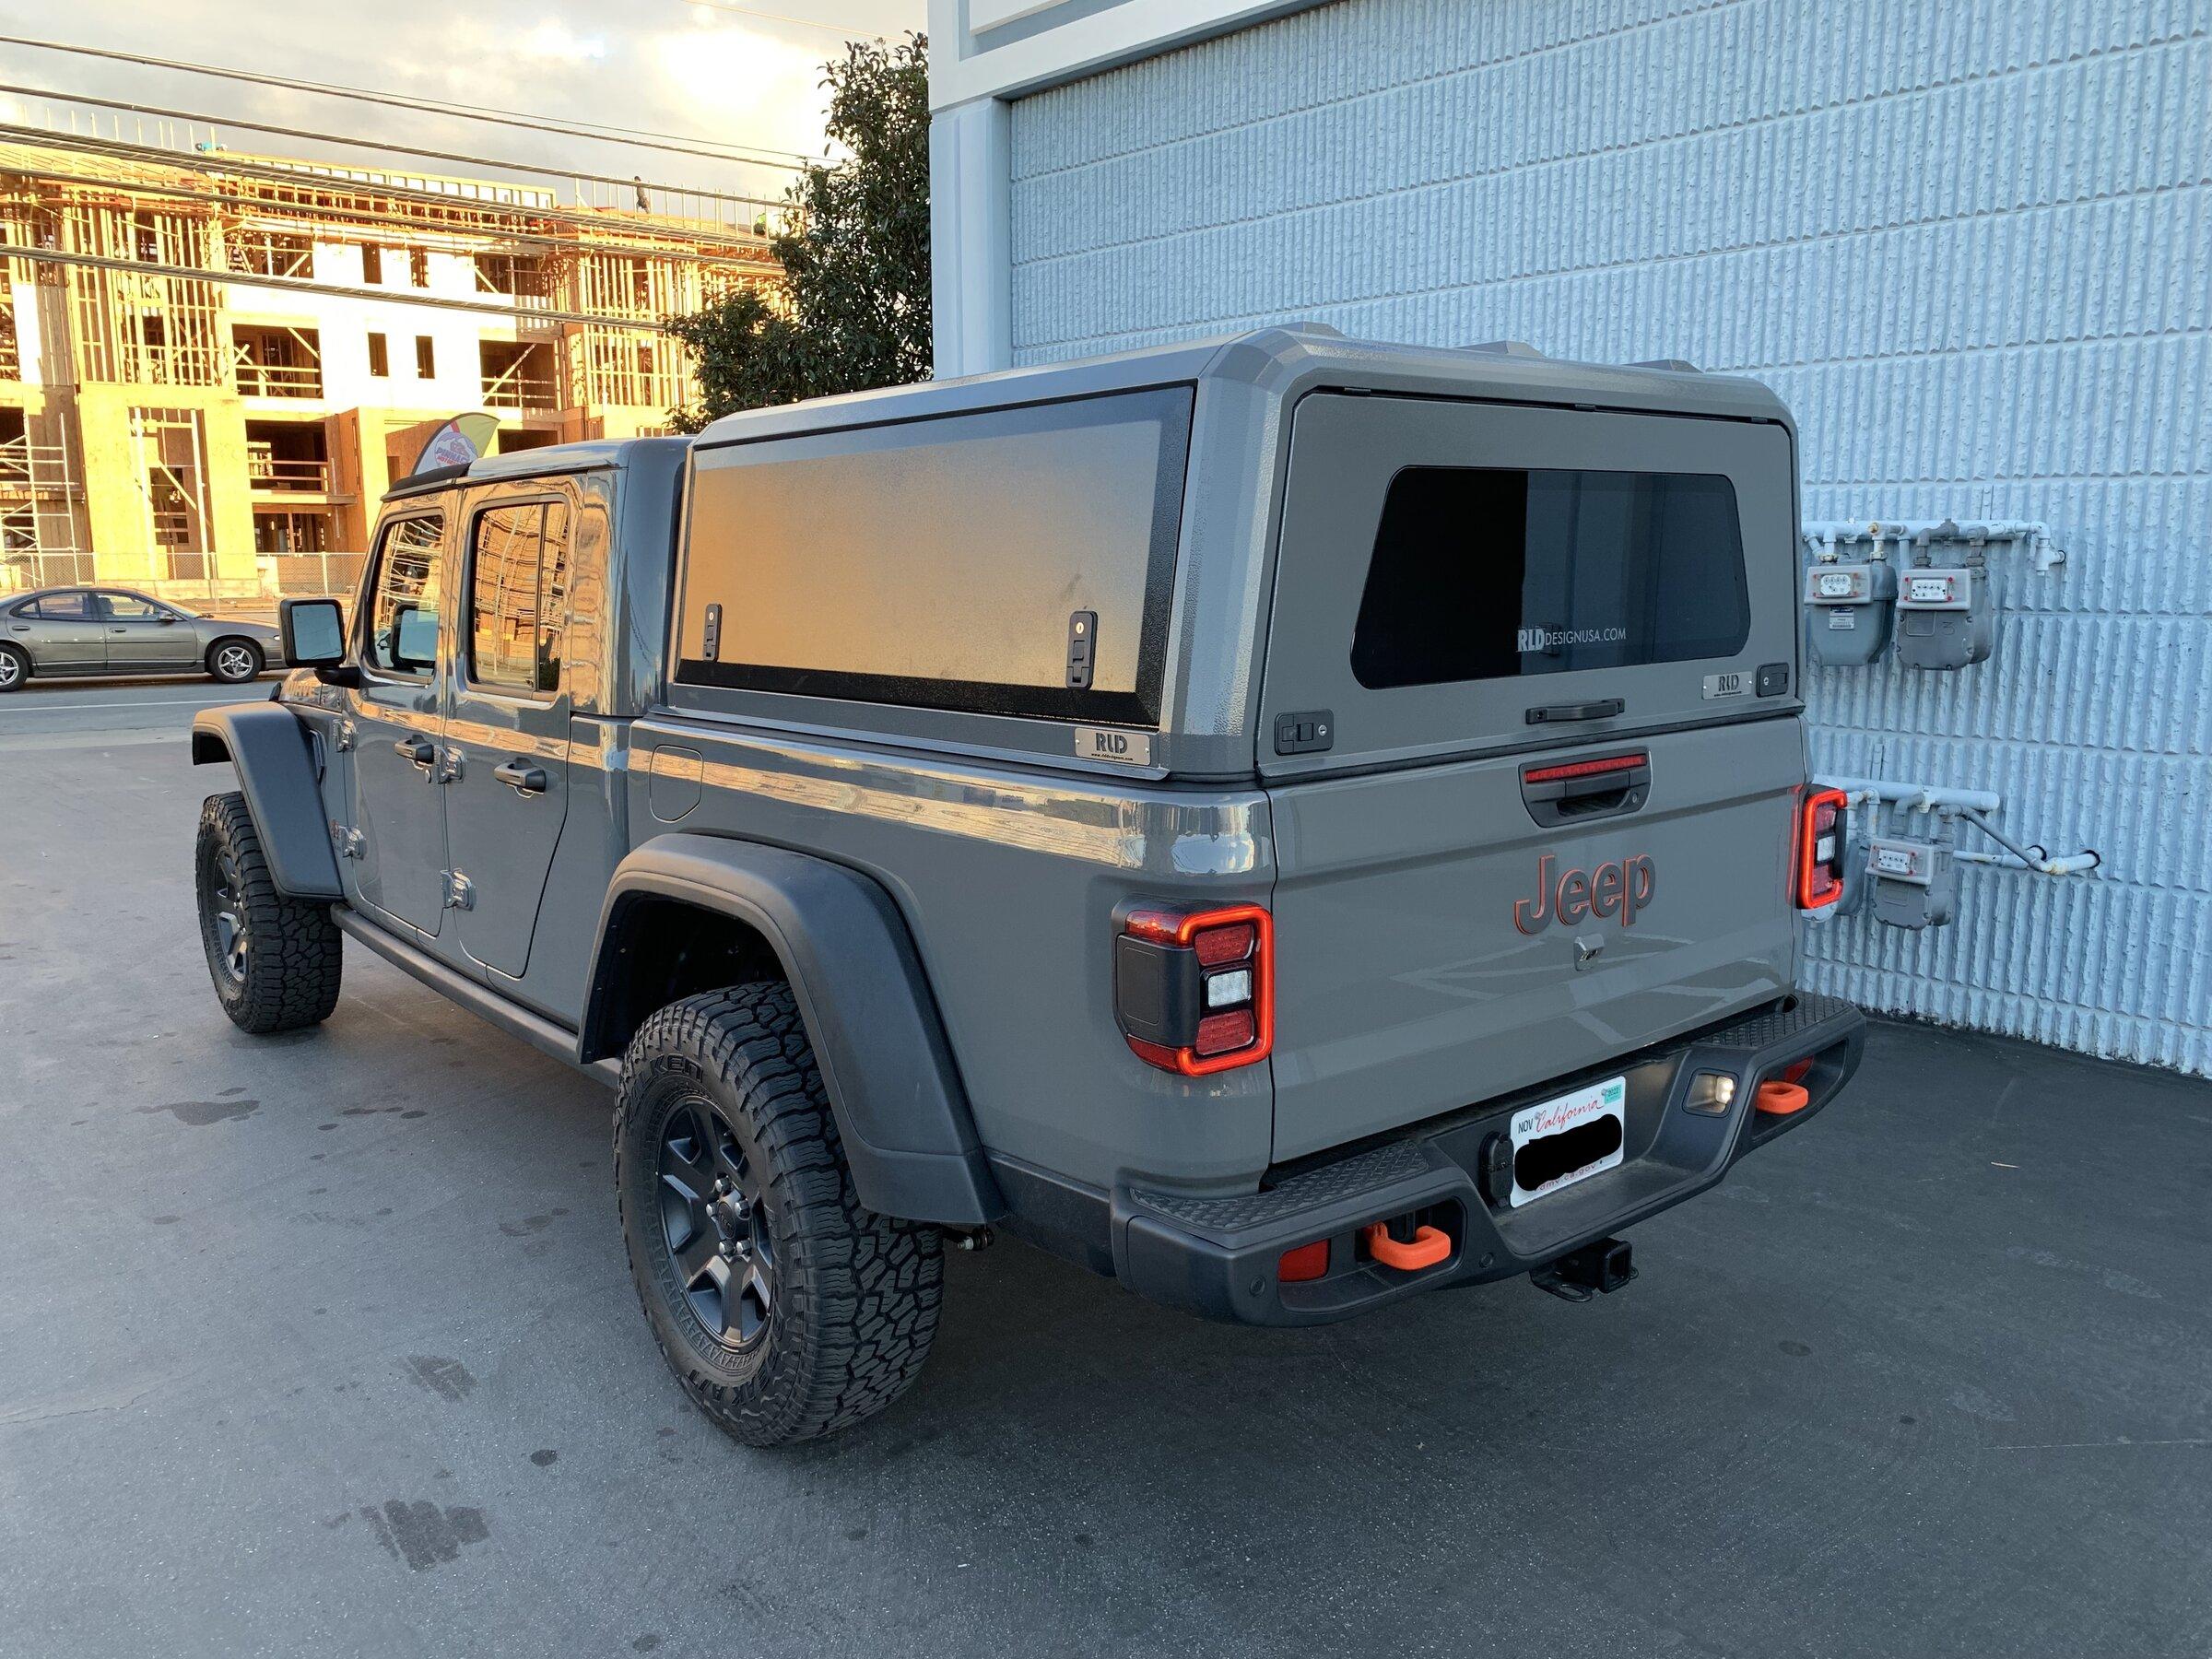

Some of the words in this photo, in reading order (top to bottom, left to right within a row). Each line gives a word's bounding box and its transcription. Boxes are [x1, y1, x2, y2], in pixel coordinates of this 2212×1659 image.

[1718, 674, 1739, 691] RLD
[1095, 732, 1128, 754] RLD
[1514, 853, 1656, 935] Jeep
[1518, 1117, 1534, 1135] NOV
[1535, 1095, 1604, 1133] California
